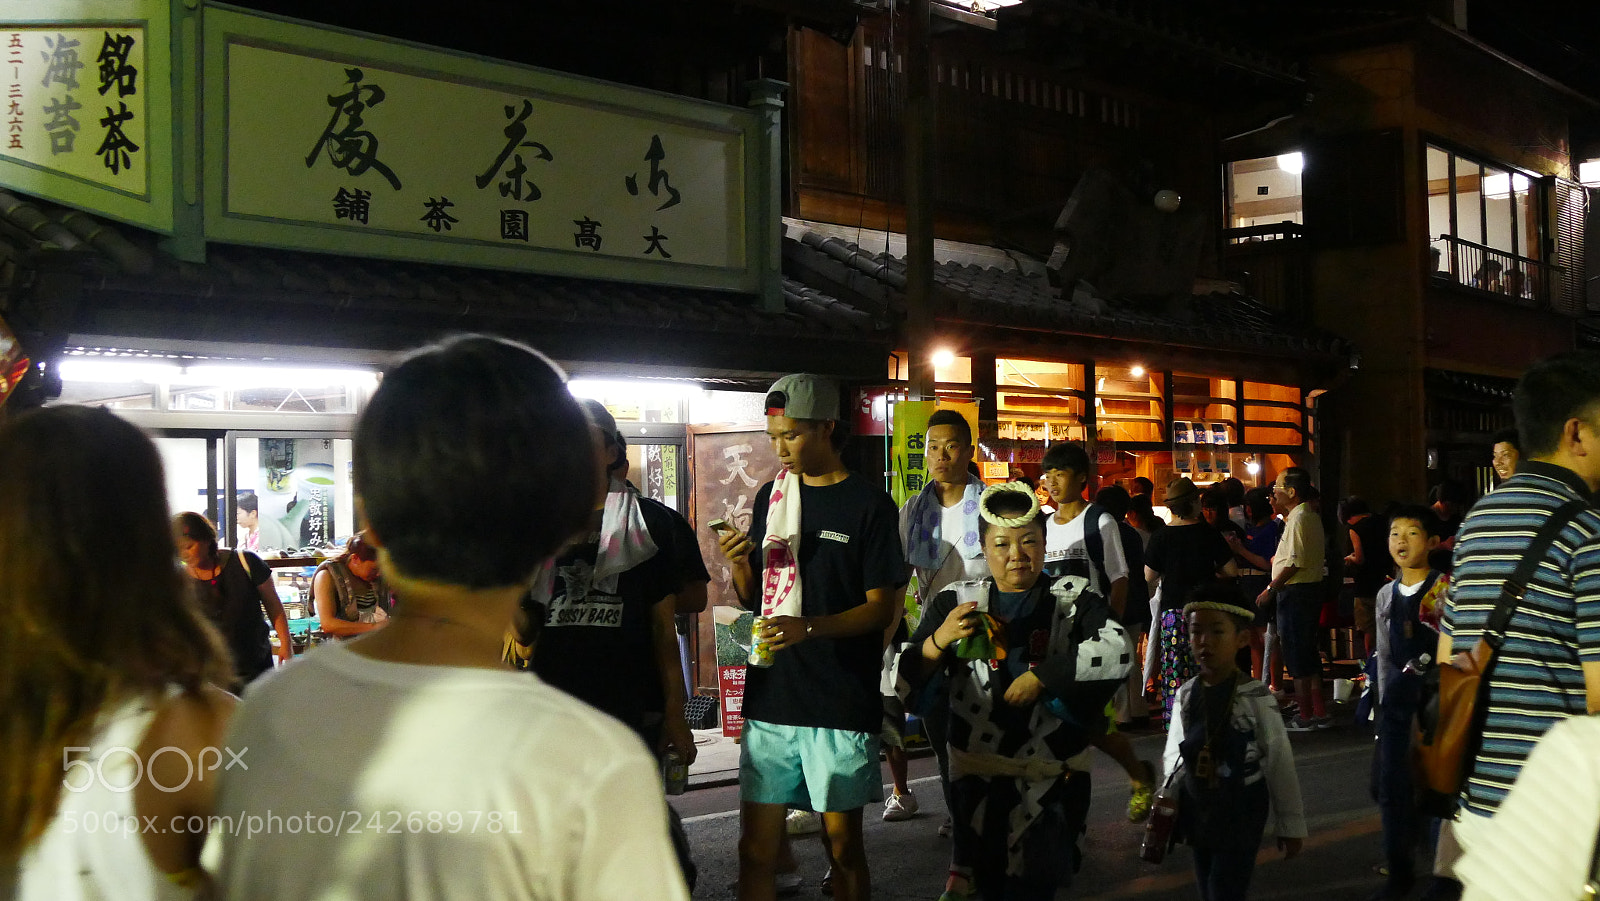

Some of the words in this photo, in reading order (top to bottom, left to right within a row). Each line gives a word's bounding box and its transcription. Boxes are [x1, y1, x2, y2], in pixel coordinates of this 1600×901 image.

[41, 33, 84, 156] 海苔
[96, 31, 140, 176] 銘茶
[588, 607, 620, 625] BARS
